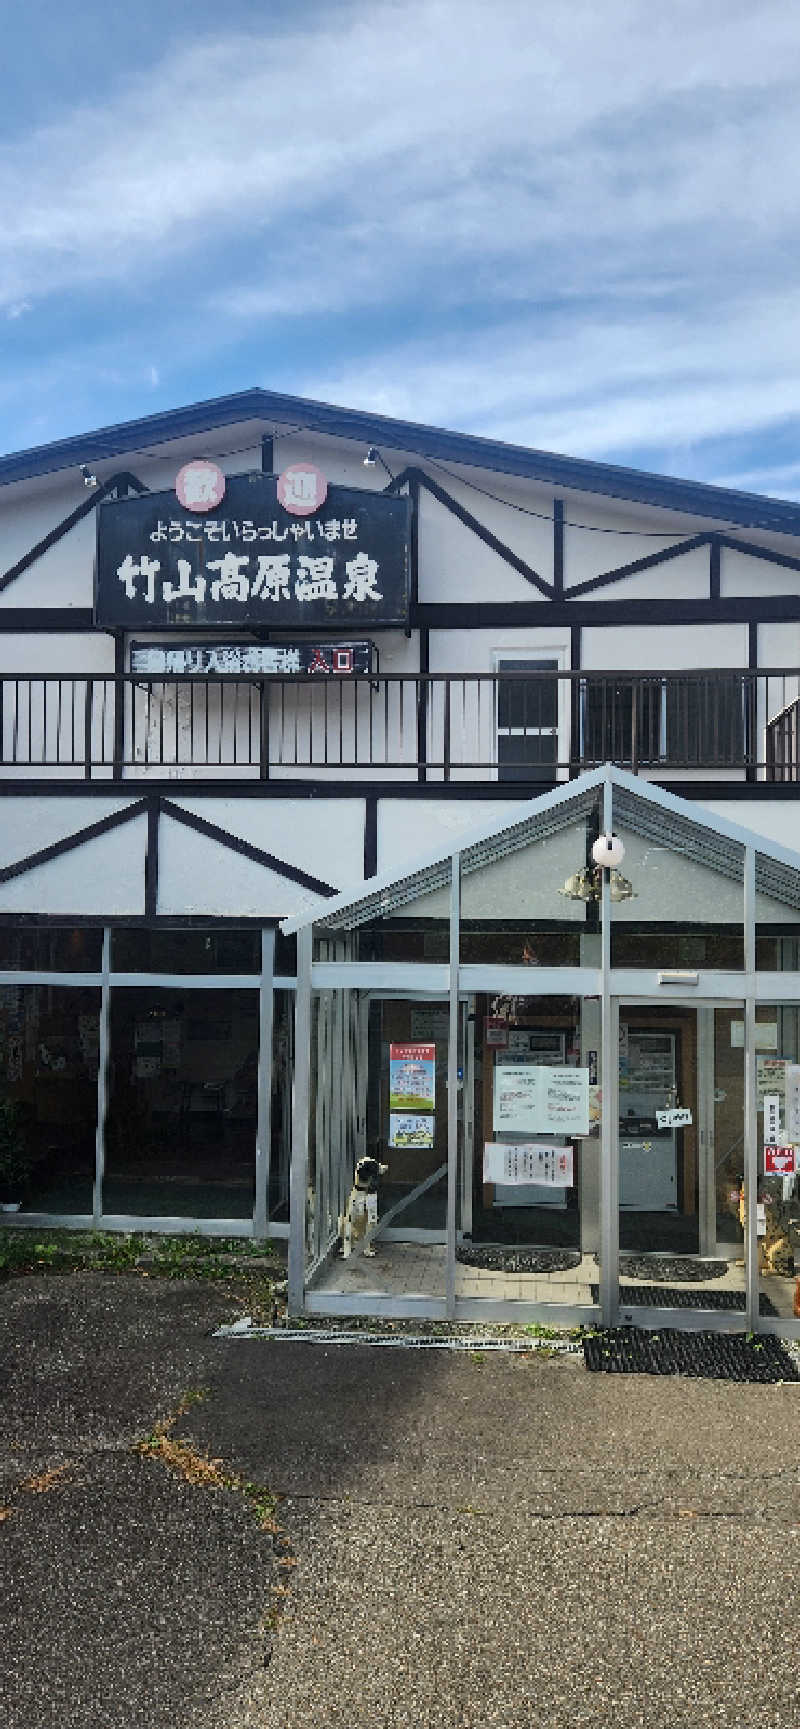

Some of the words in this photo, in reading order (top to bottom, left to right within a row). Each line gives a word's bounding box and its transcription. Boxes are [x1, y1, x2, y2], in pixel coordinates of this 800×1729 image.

[150, 518, 358, 542] ようこそいらっしゃいませ
[116, 551, 384, 603] 竹山高原温泉
[308, 649, 354, 674] 入口
